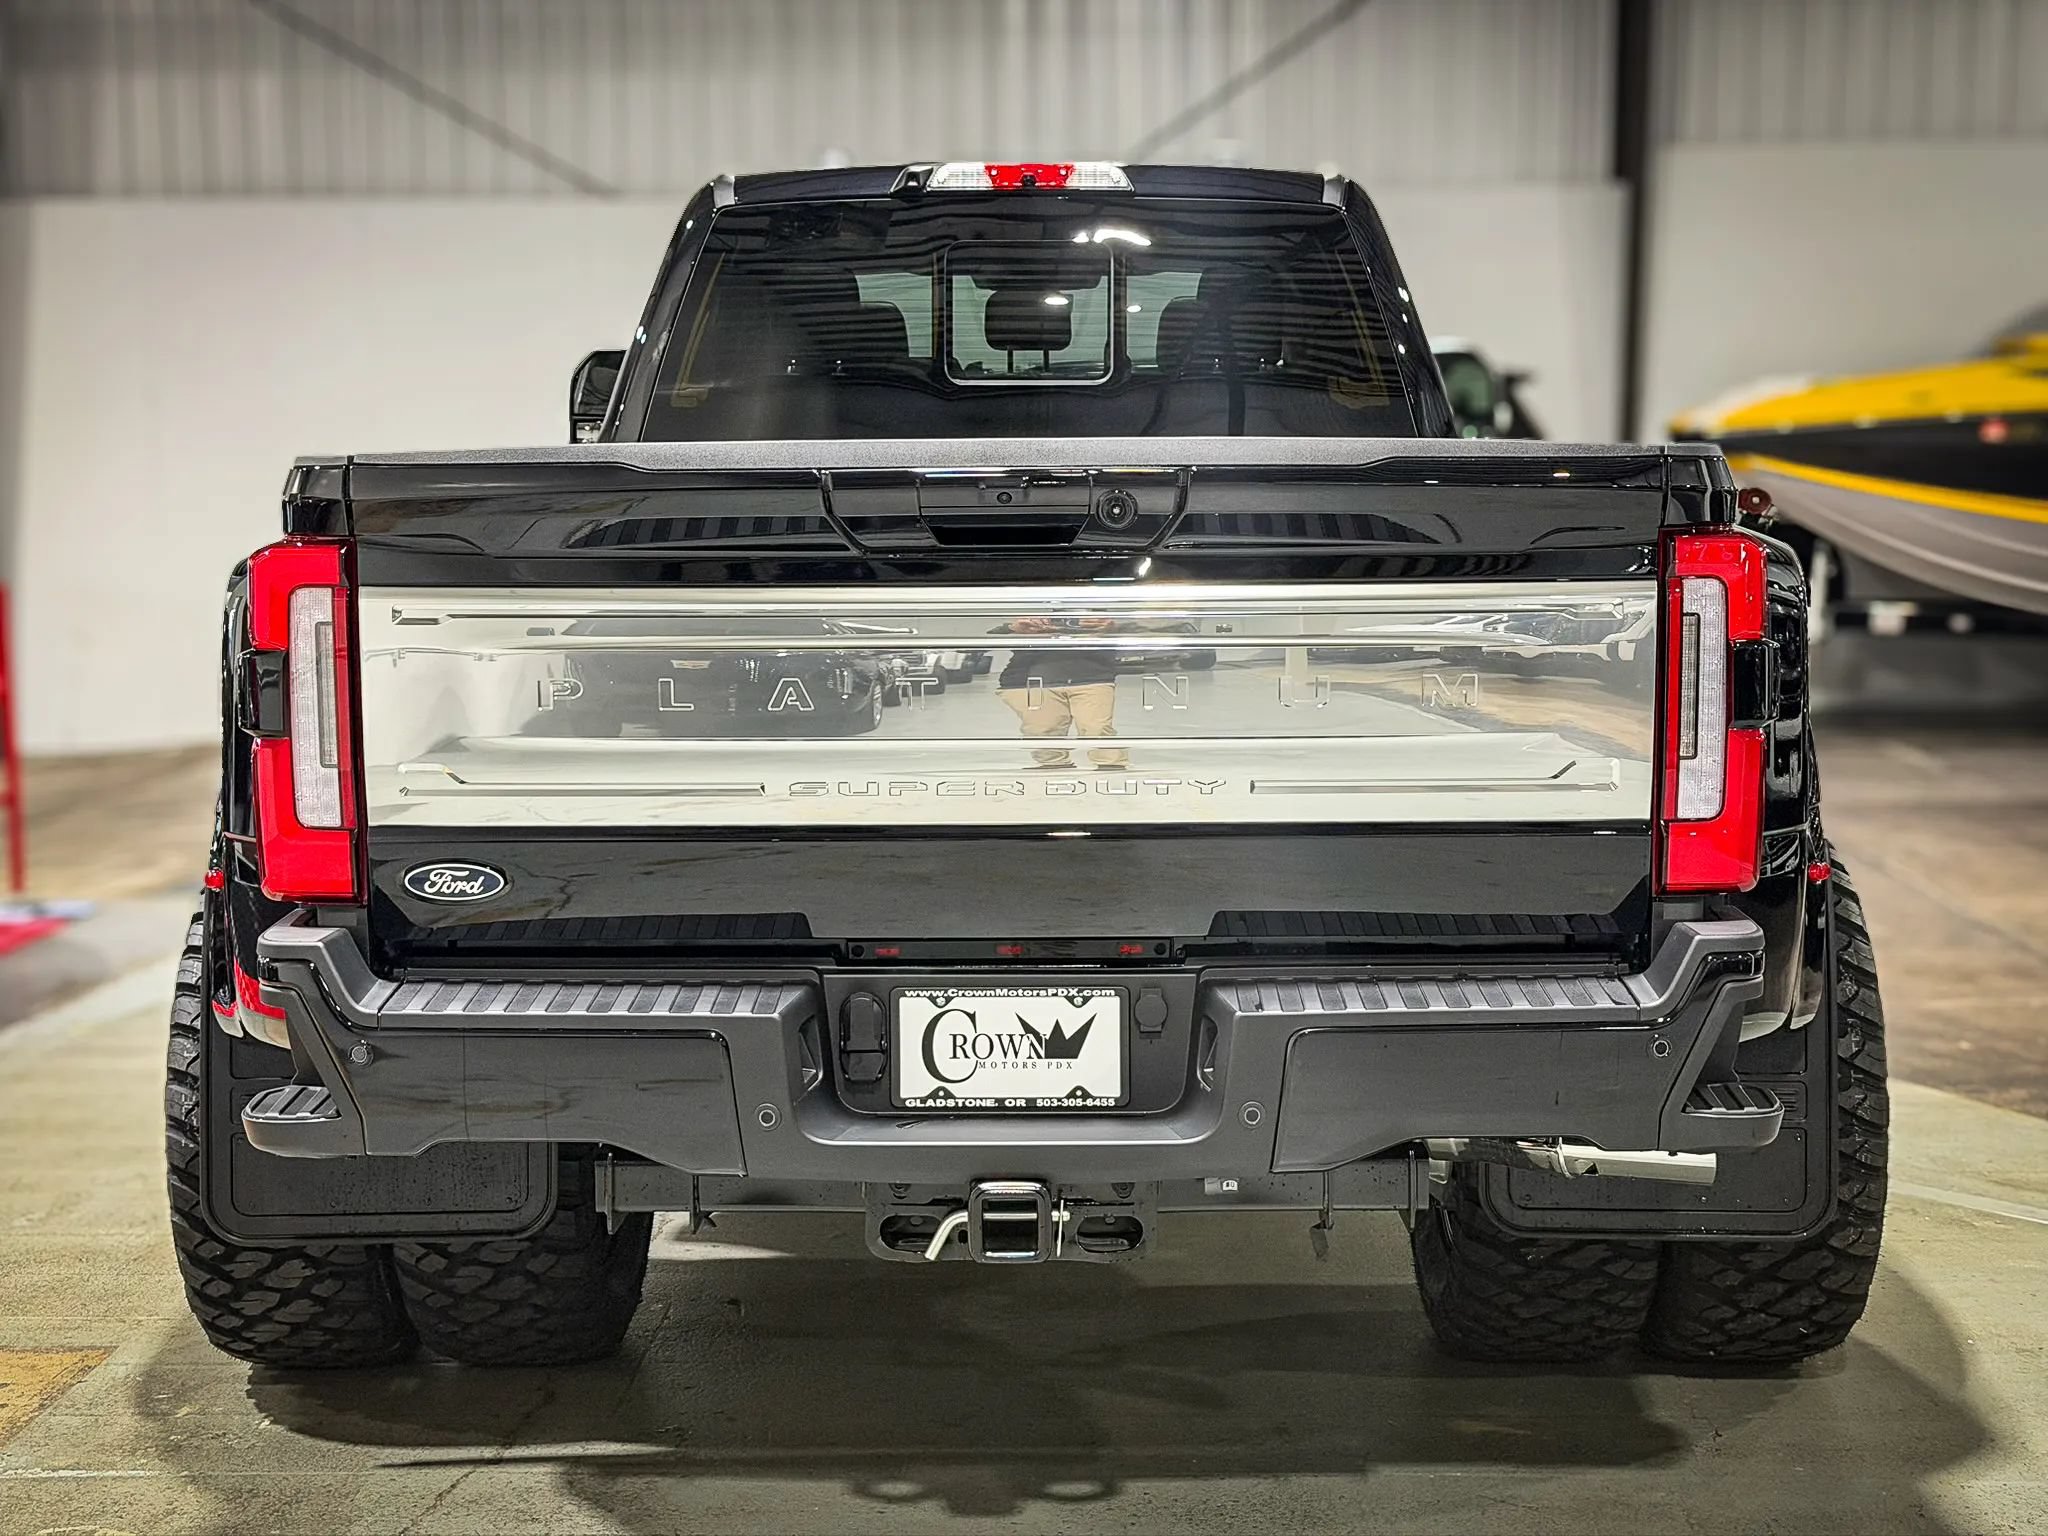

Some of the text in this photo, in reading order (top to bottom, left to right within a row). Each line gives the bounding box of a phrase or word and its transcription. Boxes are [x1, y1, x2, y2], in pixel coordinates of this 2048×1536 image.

[536, 672, 1481, 712] PLATINUM
[788, 779, 1226, 797] SUPER DUTY
[423, 868, 485, 894] Ford
[904, 988, 1116, 998] www.CrownMotorsPDX.com
[978, 1061, 1074, 1070] MOTORS PDX
[1004, 1098, 1027, 1108] OR
